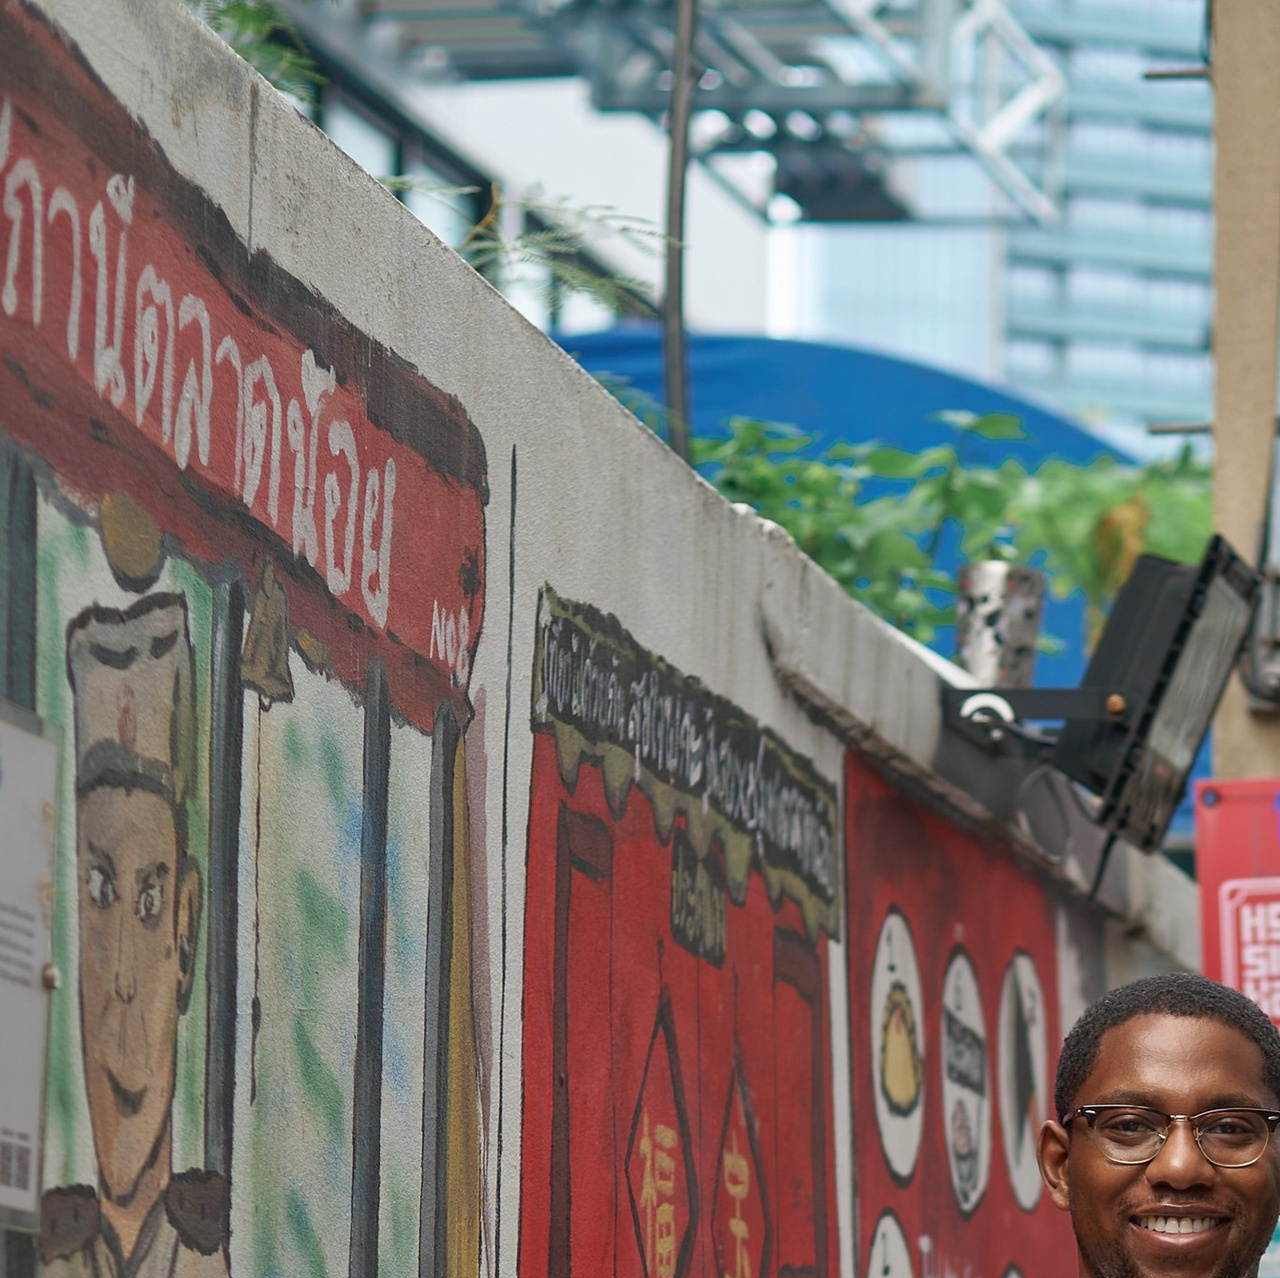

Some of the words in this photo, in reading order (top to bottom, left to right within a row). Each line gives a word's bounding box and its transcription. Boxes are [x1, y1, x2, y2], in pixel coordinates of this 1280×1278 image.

[0, 96, 396, 629] ถานีตลาดน้อย
